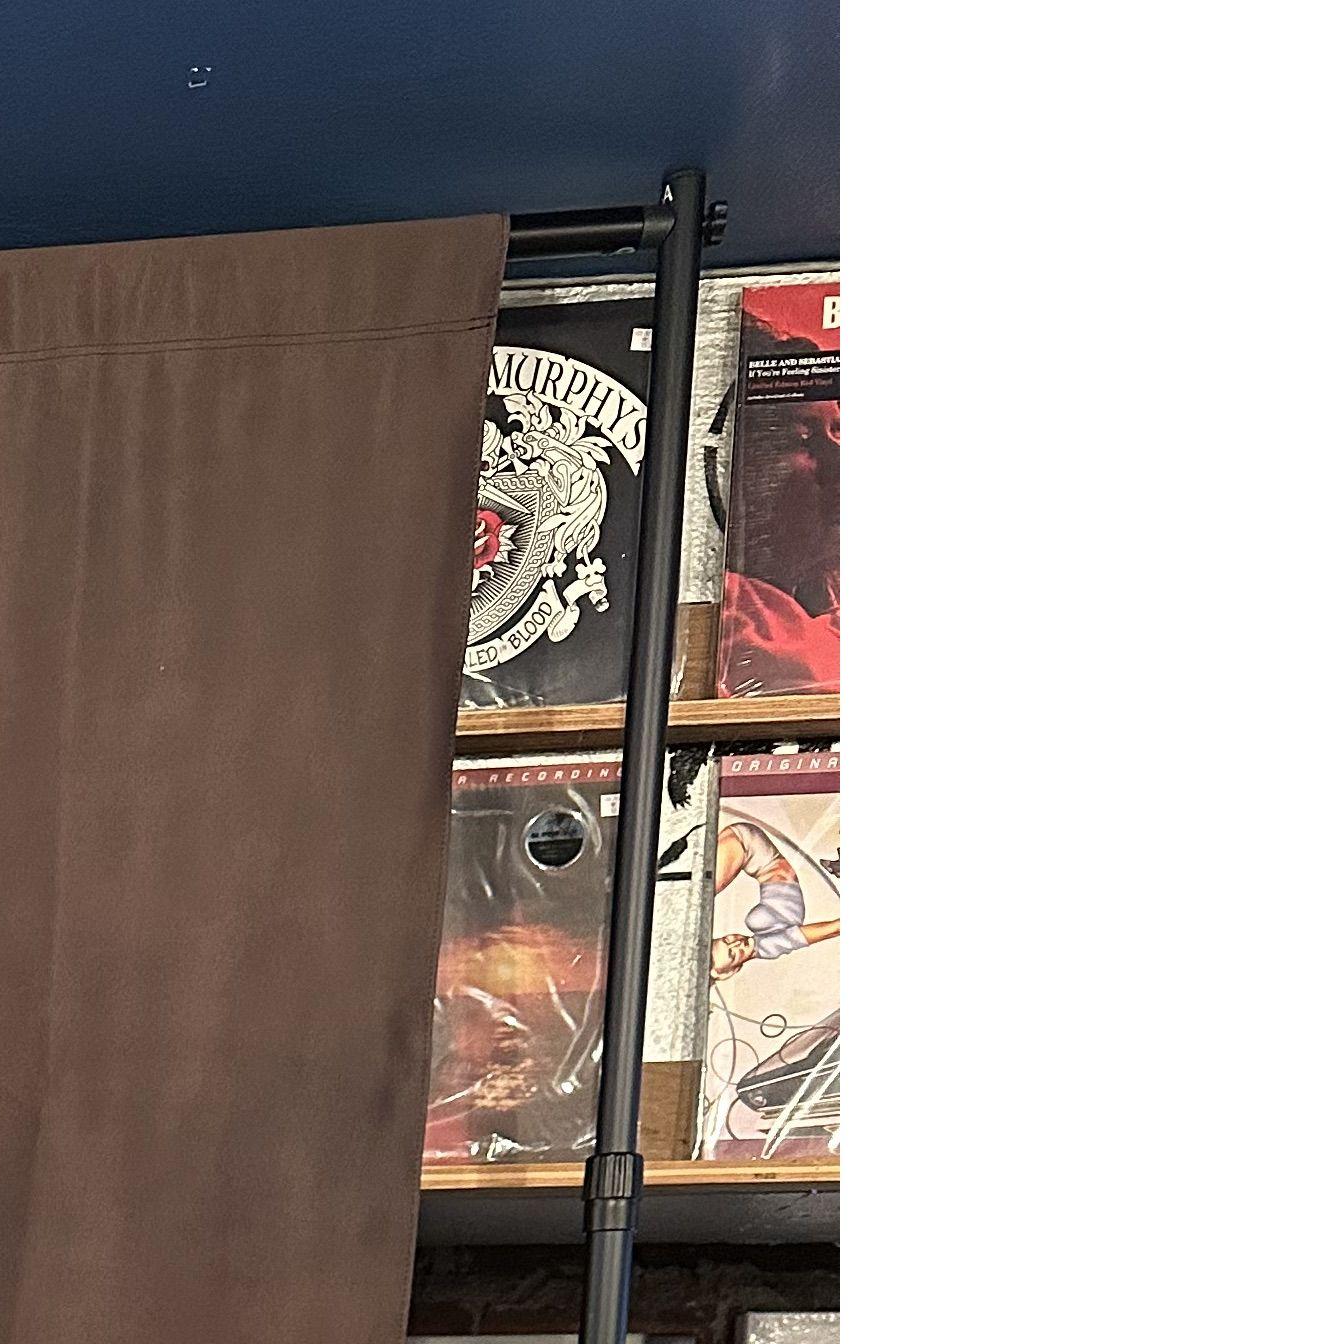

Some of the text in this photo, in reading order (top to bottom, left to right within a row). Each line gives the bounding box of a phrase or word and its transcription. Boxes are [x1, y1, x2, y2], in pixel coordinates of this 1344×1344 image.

[778, 359, 797, 367] AND
[489, 352, 646, 450] MURPHYS
[508, 602, 552, 649] BLOOD
